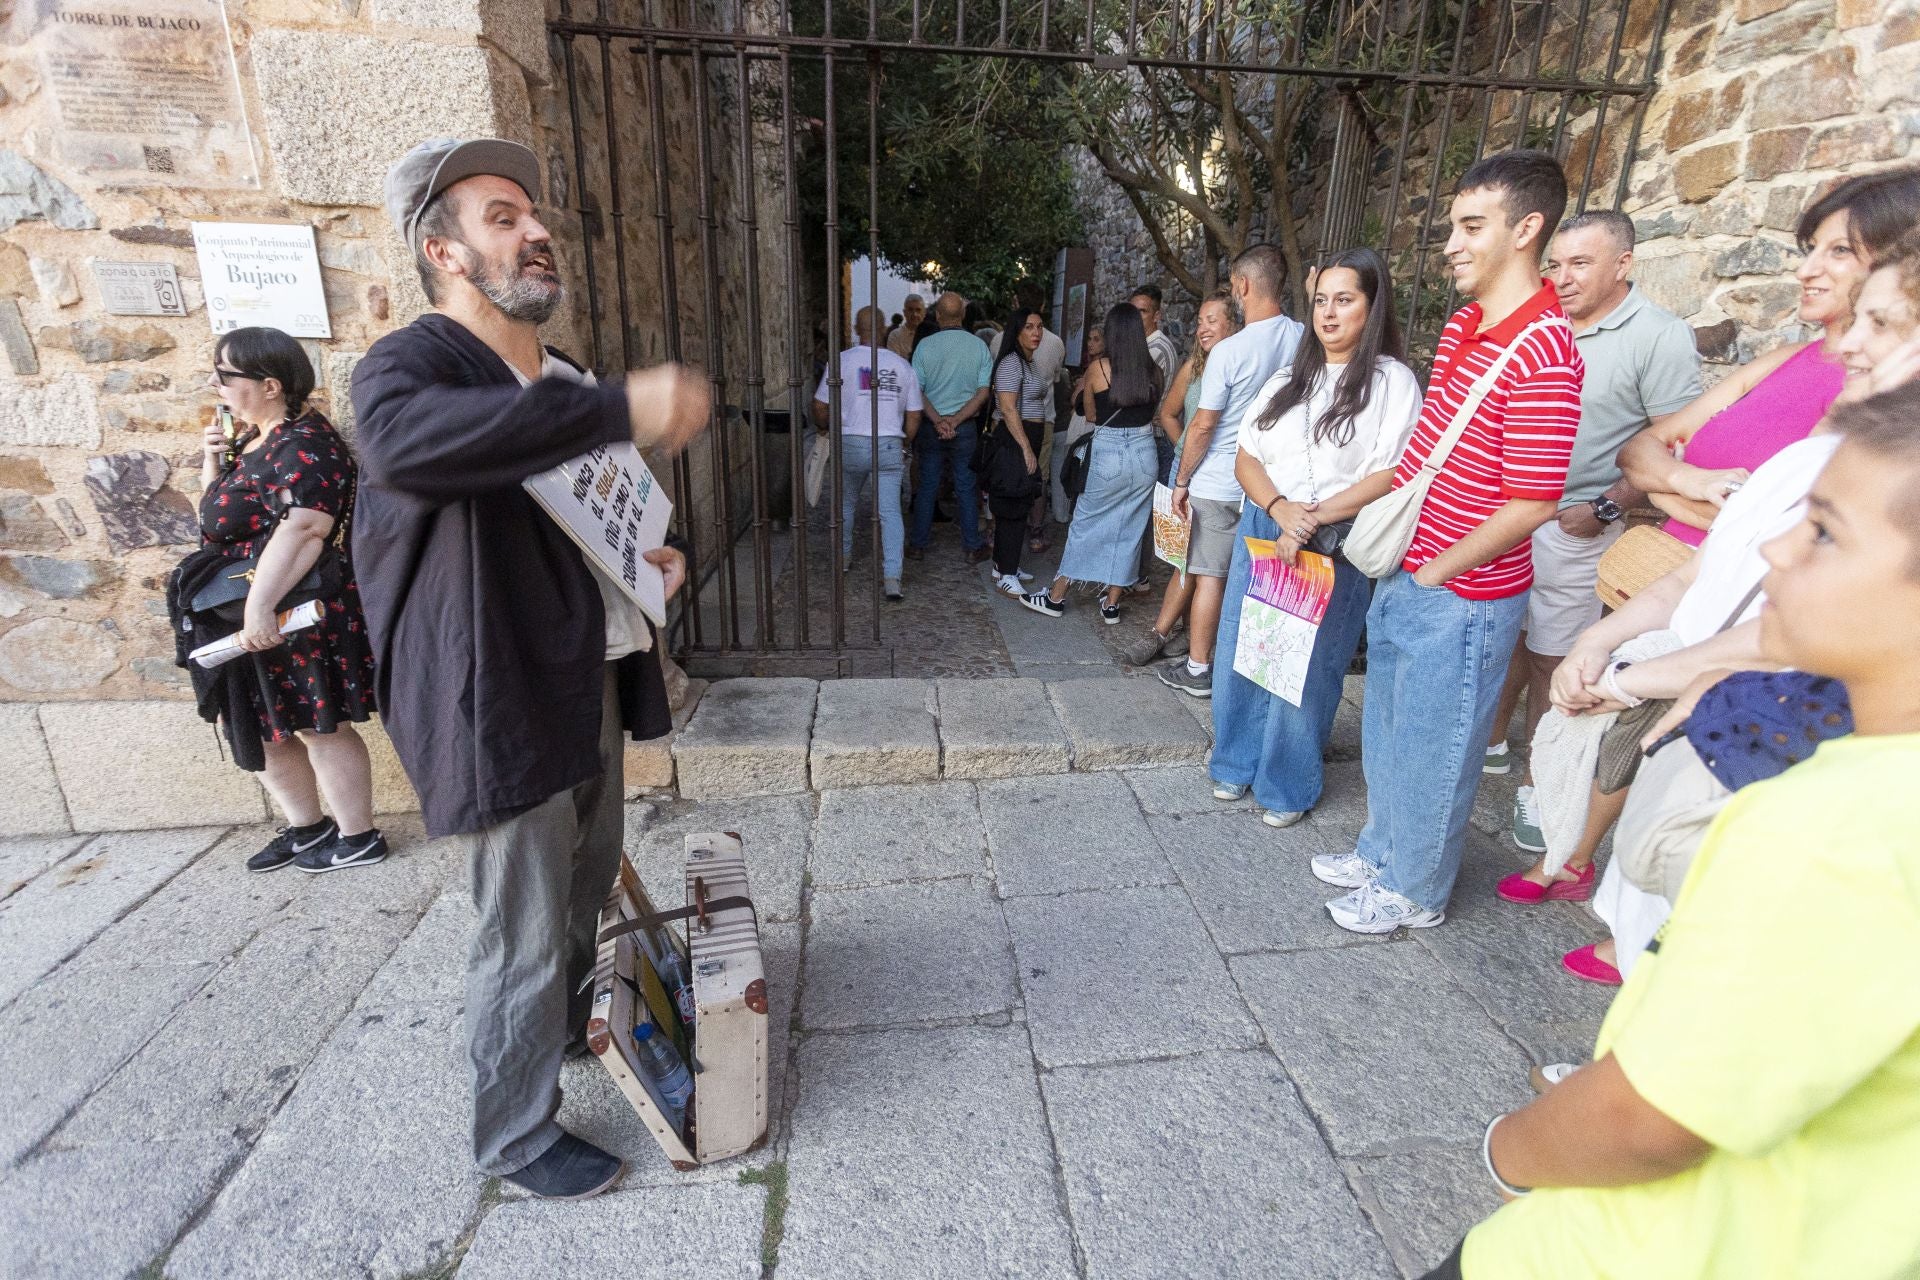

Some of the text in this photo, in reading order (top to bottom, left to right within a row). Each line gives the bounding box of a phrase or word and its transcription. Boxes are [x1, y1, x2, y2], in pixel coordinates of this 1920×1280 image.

[51, 10, 201, 31] TORRE DE BUJACO
[198, 233, 311, 249] Conjunto Patrimonial
[290, 251, 303, 262] de
[226, 263, 298, 290] Bujaco
[612, 483, 630, 520] COMO
